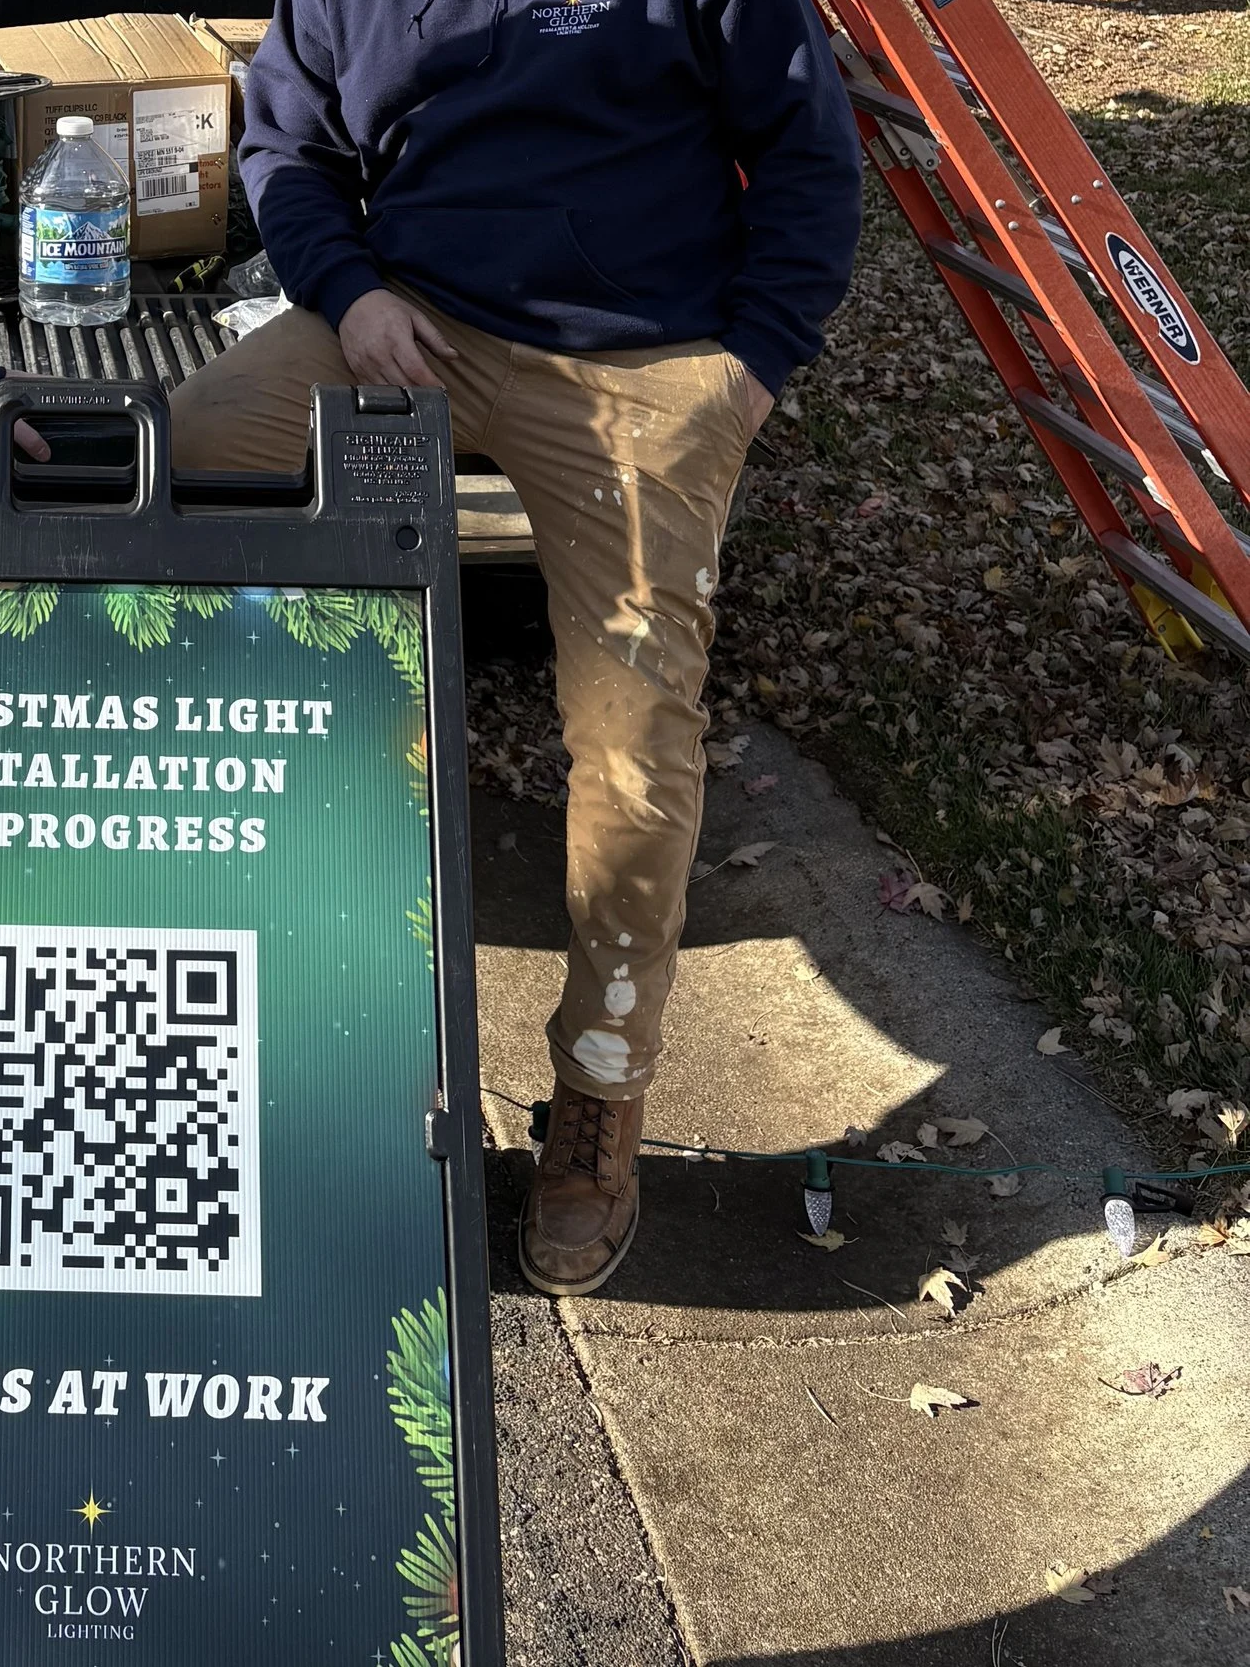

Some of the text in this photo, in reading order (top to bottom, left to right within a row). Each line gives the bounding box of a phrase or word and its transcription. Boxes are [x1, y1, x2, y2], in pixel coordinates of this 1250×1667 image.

[532, 1, 611, 19] NORTHERN
[549, 14, 591, 27] GLOW
[45, 103, 98, 114] TUFF CLIPS LLC
[105, 112, 127, 122] BLACK
[42, 240, 125, 256] ICE MOUNTAIN
[1123, 259, 1184, 339] WERNER
[174, 696, 333, 735] LIGHT
[47, 1370, 128, 1416] AT
[144, 1371, 331, 1422] WORK
[34, 1584, 149, 1617] GLOW
[47, 1623, 135, 1640] LIGHTING
